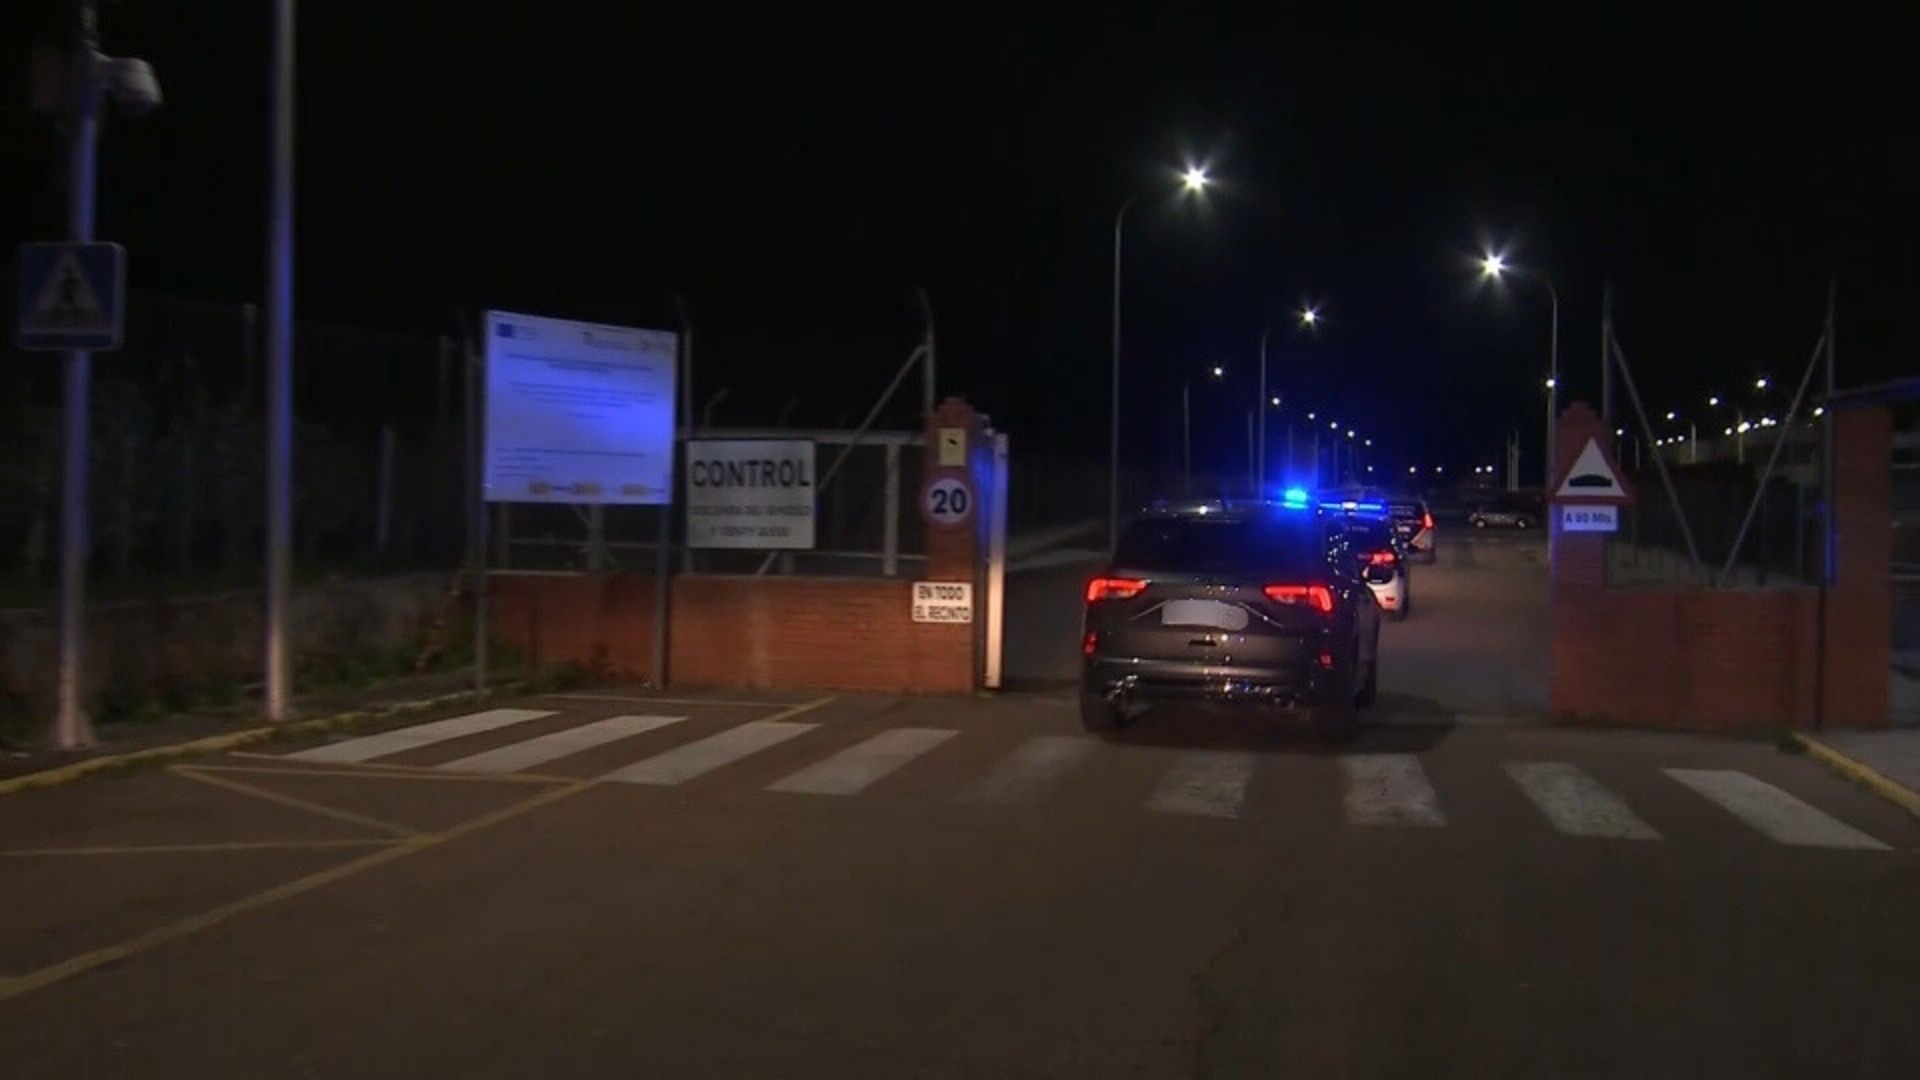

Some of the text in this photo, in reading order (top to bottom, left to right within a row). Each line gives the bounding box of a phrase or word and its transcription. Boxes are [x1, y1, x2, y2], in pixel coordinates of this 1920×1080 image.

[692, 459, 811, 488] CONTROL
[931, 488, 967, 515] 20
[1566, 512, 1573, 523] A
[918, 585, 964, 601] EN TODO
[915, 604, 971, 621] EL RECINTO
